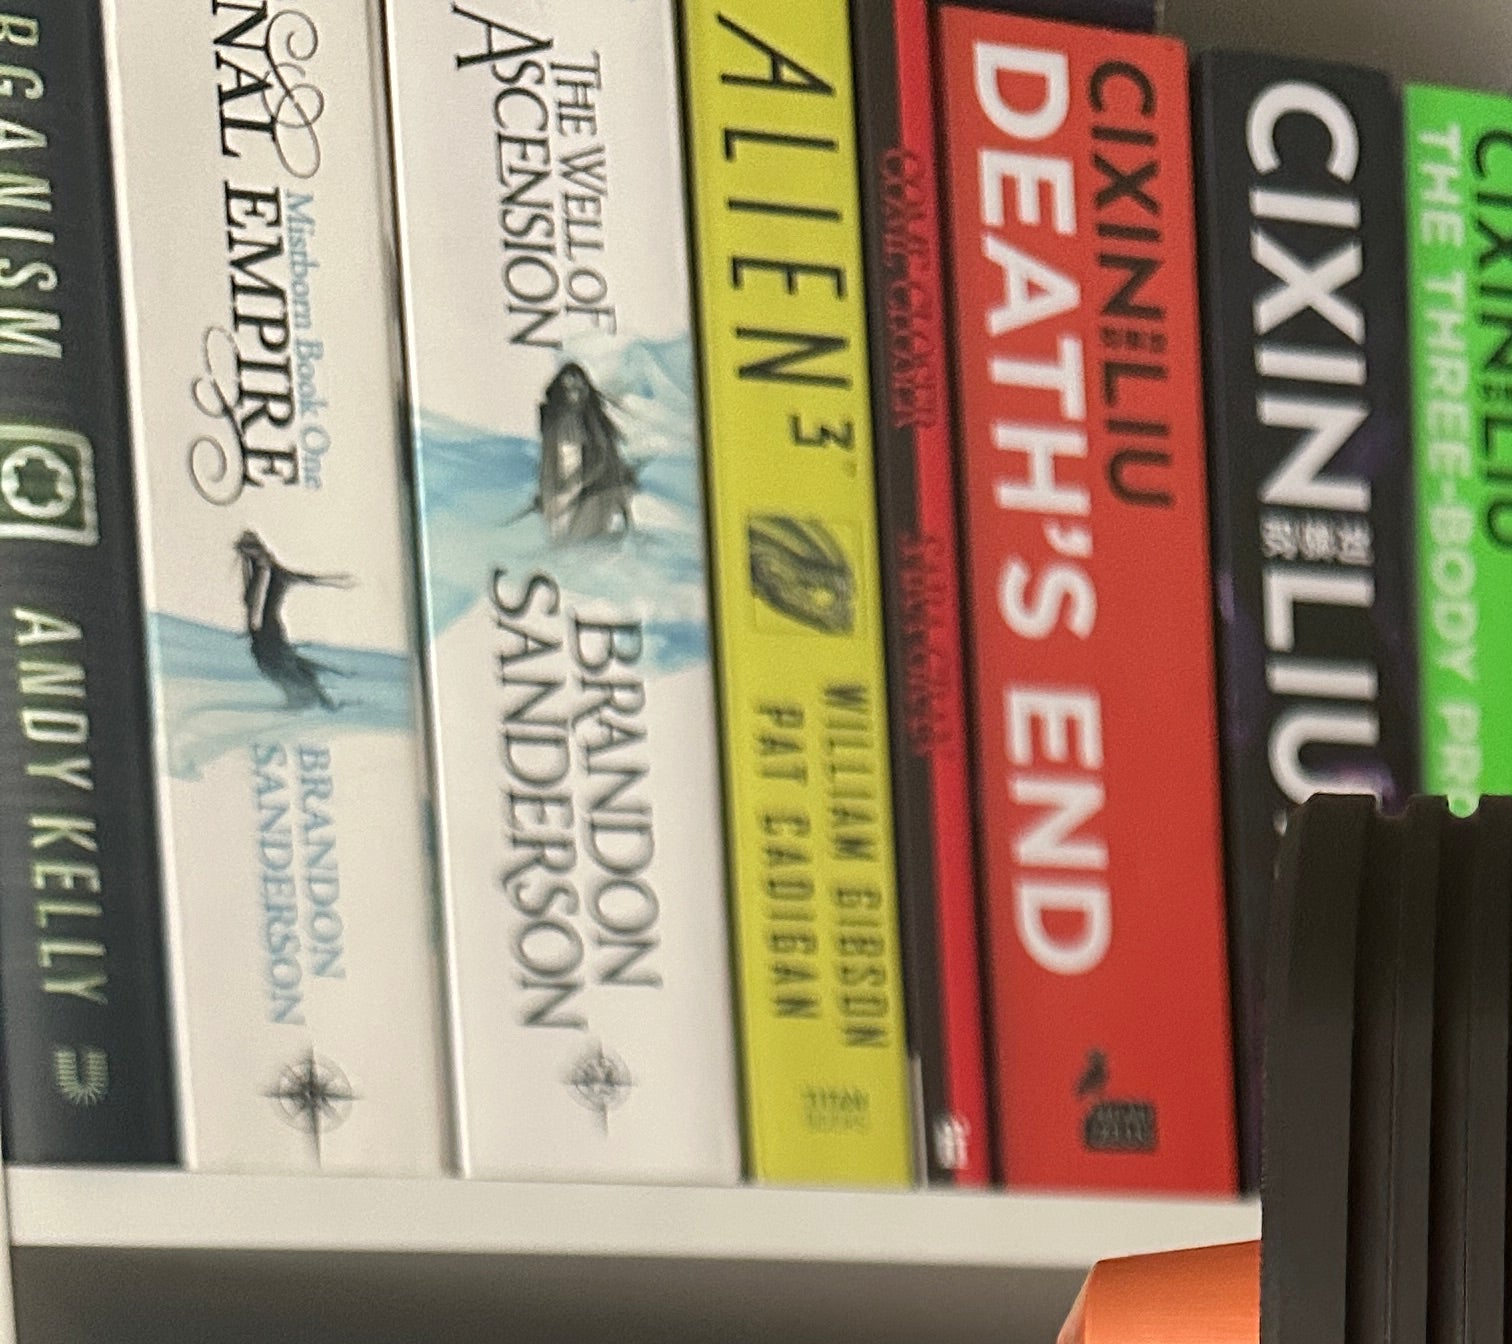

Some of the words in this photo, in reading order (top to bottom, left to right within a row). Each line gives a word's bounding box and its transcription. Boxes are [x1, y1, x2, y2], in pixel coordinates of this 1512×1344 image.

[453, 4, 563, 350] ASCENSION
[549, 50, 605, 138] THE
[1087, 60, 1169, 321] CIXIN
[1418, 123, 1466, 248] THE
[286, 190, 320, 330] Mistborn
[557, 144, 611, 262] WELL
[564, 267, 618, 336] OF
[717, 11, 853, 391] ALIEN
[1246, 81, 1374, 512] CIXIN
[223, 180, 301, 489] EMPIRE
[295, 337, 329, 420] Book
[972, 39, 1099, 641] DEATH'S
[1103, 360, 1178, 508] LIU
[299, 425, 329, 491] One
[1422, 274, 1480, 683] THREE-BODY
[13, 606, 94, 792] ANDY
[753, 701, 808, 788] PAT
[819, 681, 876, 865] WILLIAM
[1259, 568, 1382, 802] LIU
[250, 741, 307, 1026] SANDERSON
[298, 746, 347, 981] BRANDON
[488, 565, 590, 1032] SANDERSON
[567, 609, 664, 991] BRANDON
[1004, 686, 1115, 977] END
[27, 814, 109, 1006] KELLY
[760, 808, 821, 1021] CADIGAN
[832, 879, 891, 1050] GIBSON
